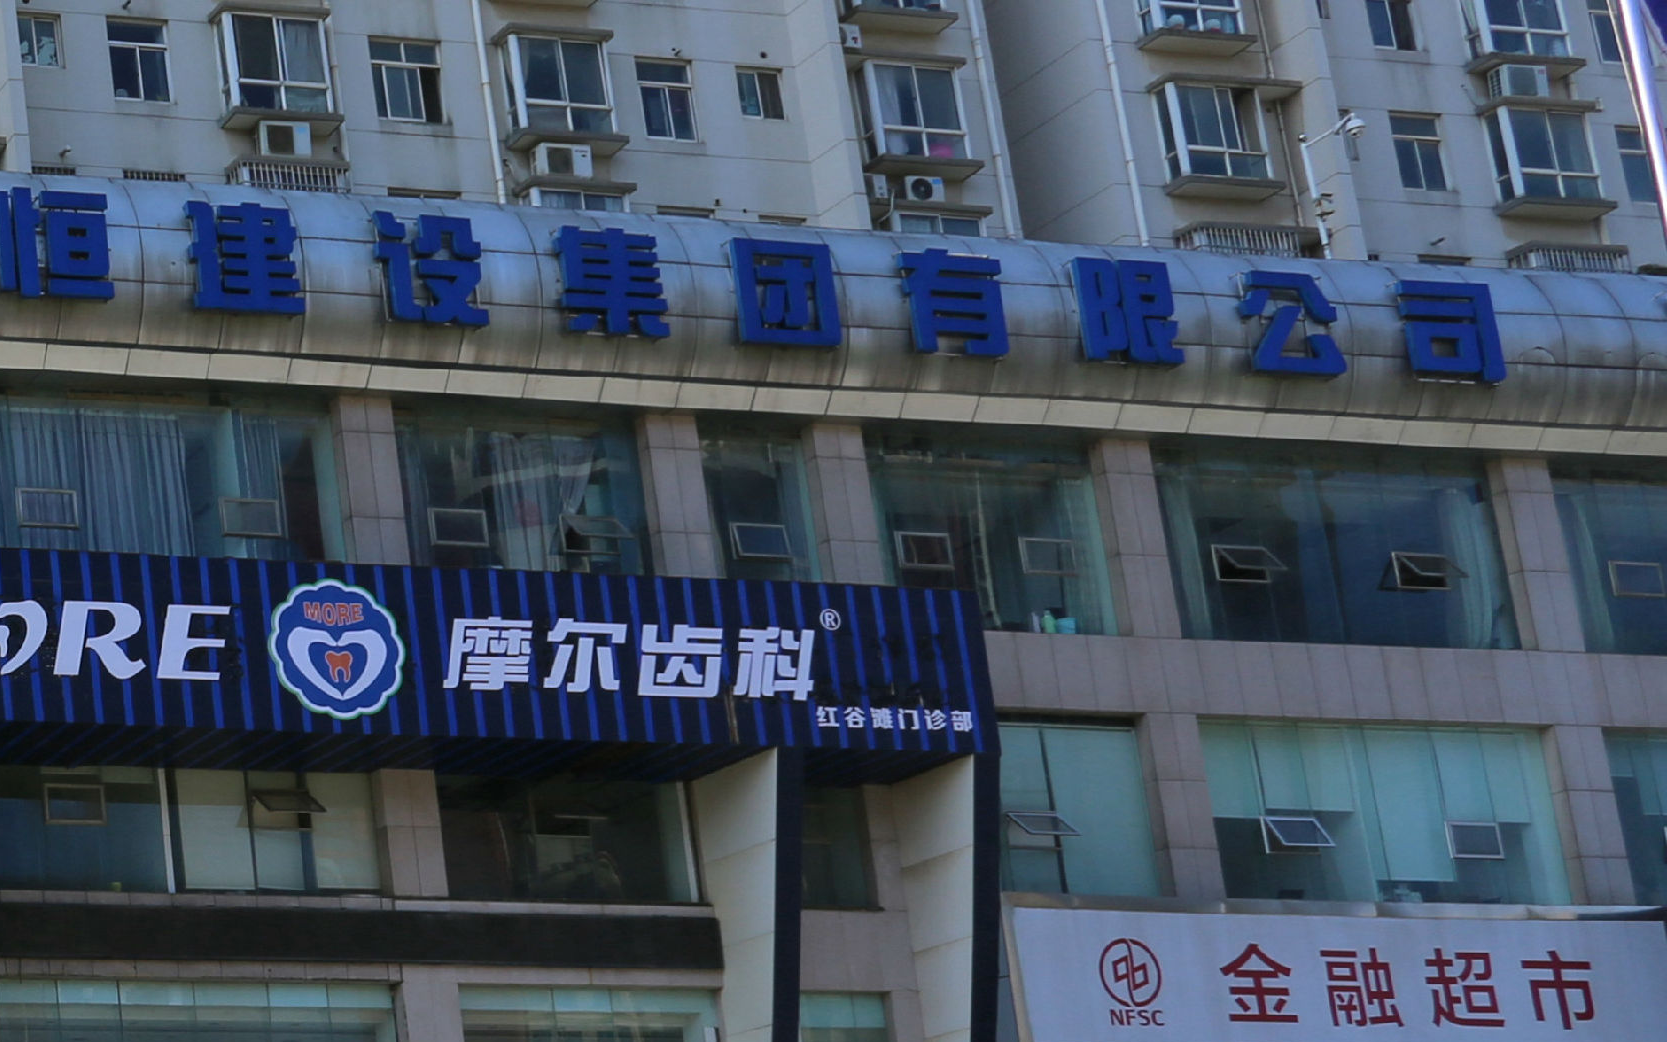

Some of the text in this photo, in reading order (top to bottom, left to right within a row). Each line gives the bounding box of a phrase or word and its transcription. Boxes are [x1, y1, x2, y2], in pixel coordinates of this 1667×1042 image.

[302, 599, 364, 627] MORE
[443, 616, 816, 702] 摩尔齿科
[816, 706, 974, 733] 红谷滩门诊部
[1220, 943, 1596, 1031] 金融超市
[1109, 1008, 1165, 1027] NFSC
